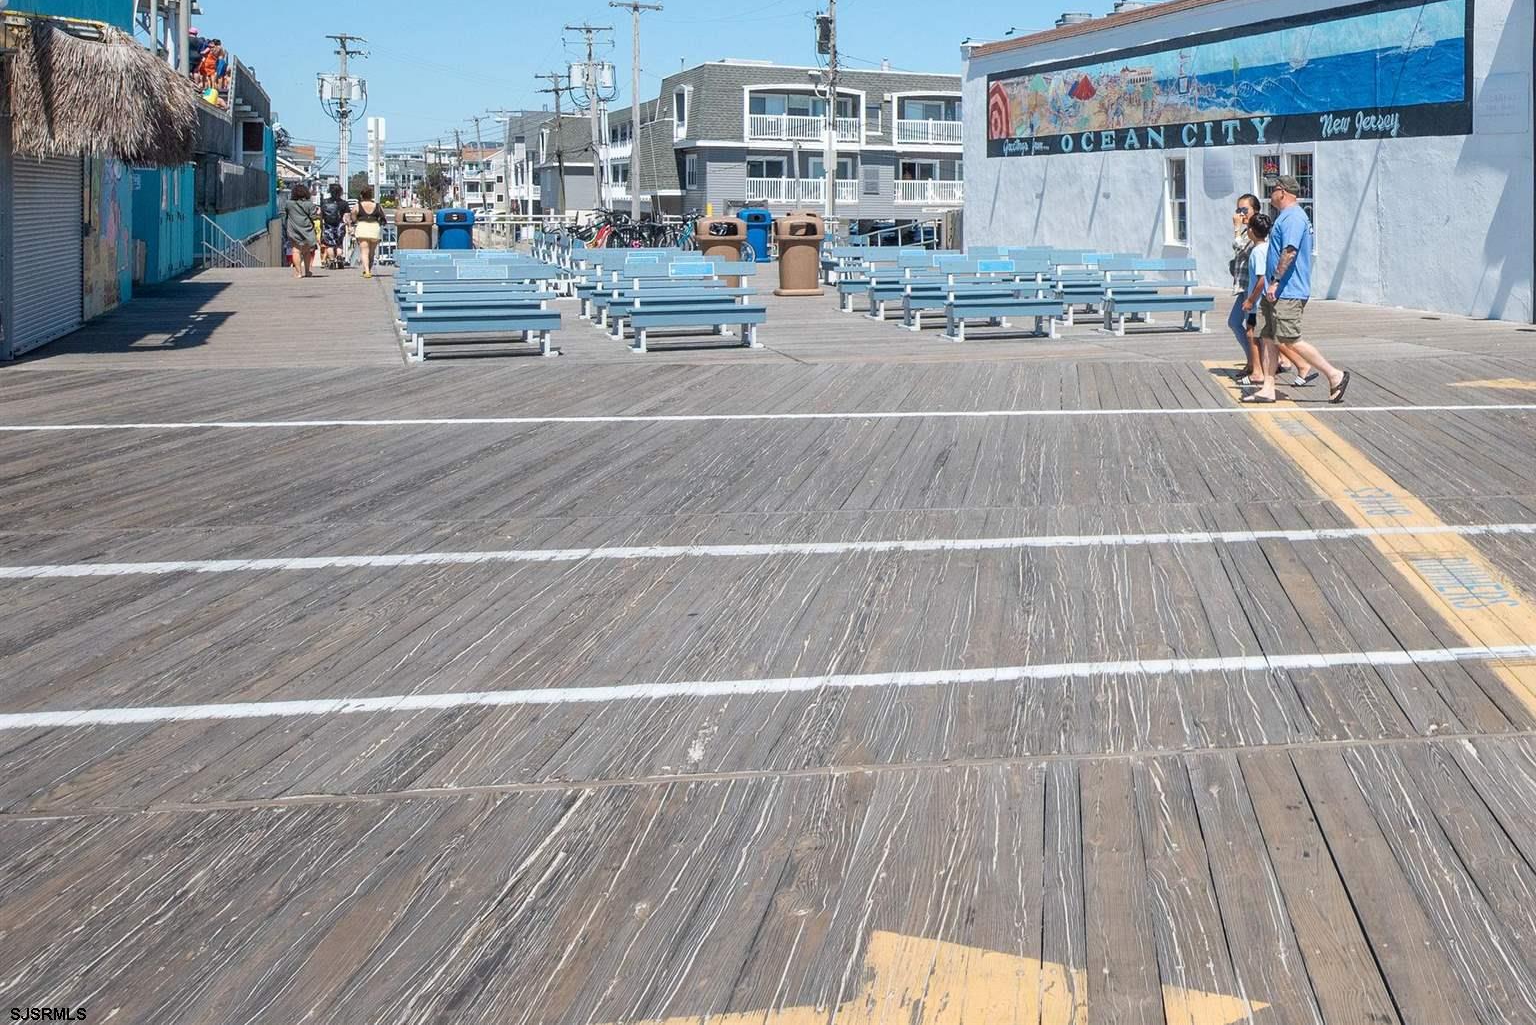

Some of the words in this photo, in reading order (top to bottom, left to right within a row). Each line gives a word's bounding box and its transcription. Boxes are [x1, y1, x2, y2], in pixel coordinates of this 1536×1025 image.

[1061, 127, 1165, 152] OCEAN
[1182, 117, 1272, 147] CITY
[1320, 114, 1351, 138] New
[1355, 110, 1400, 139] Jersey
